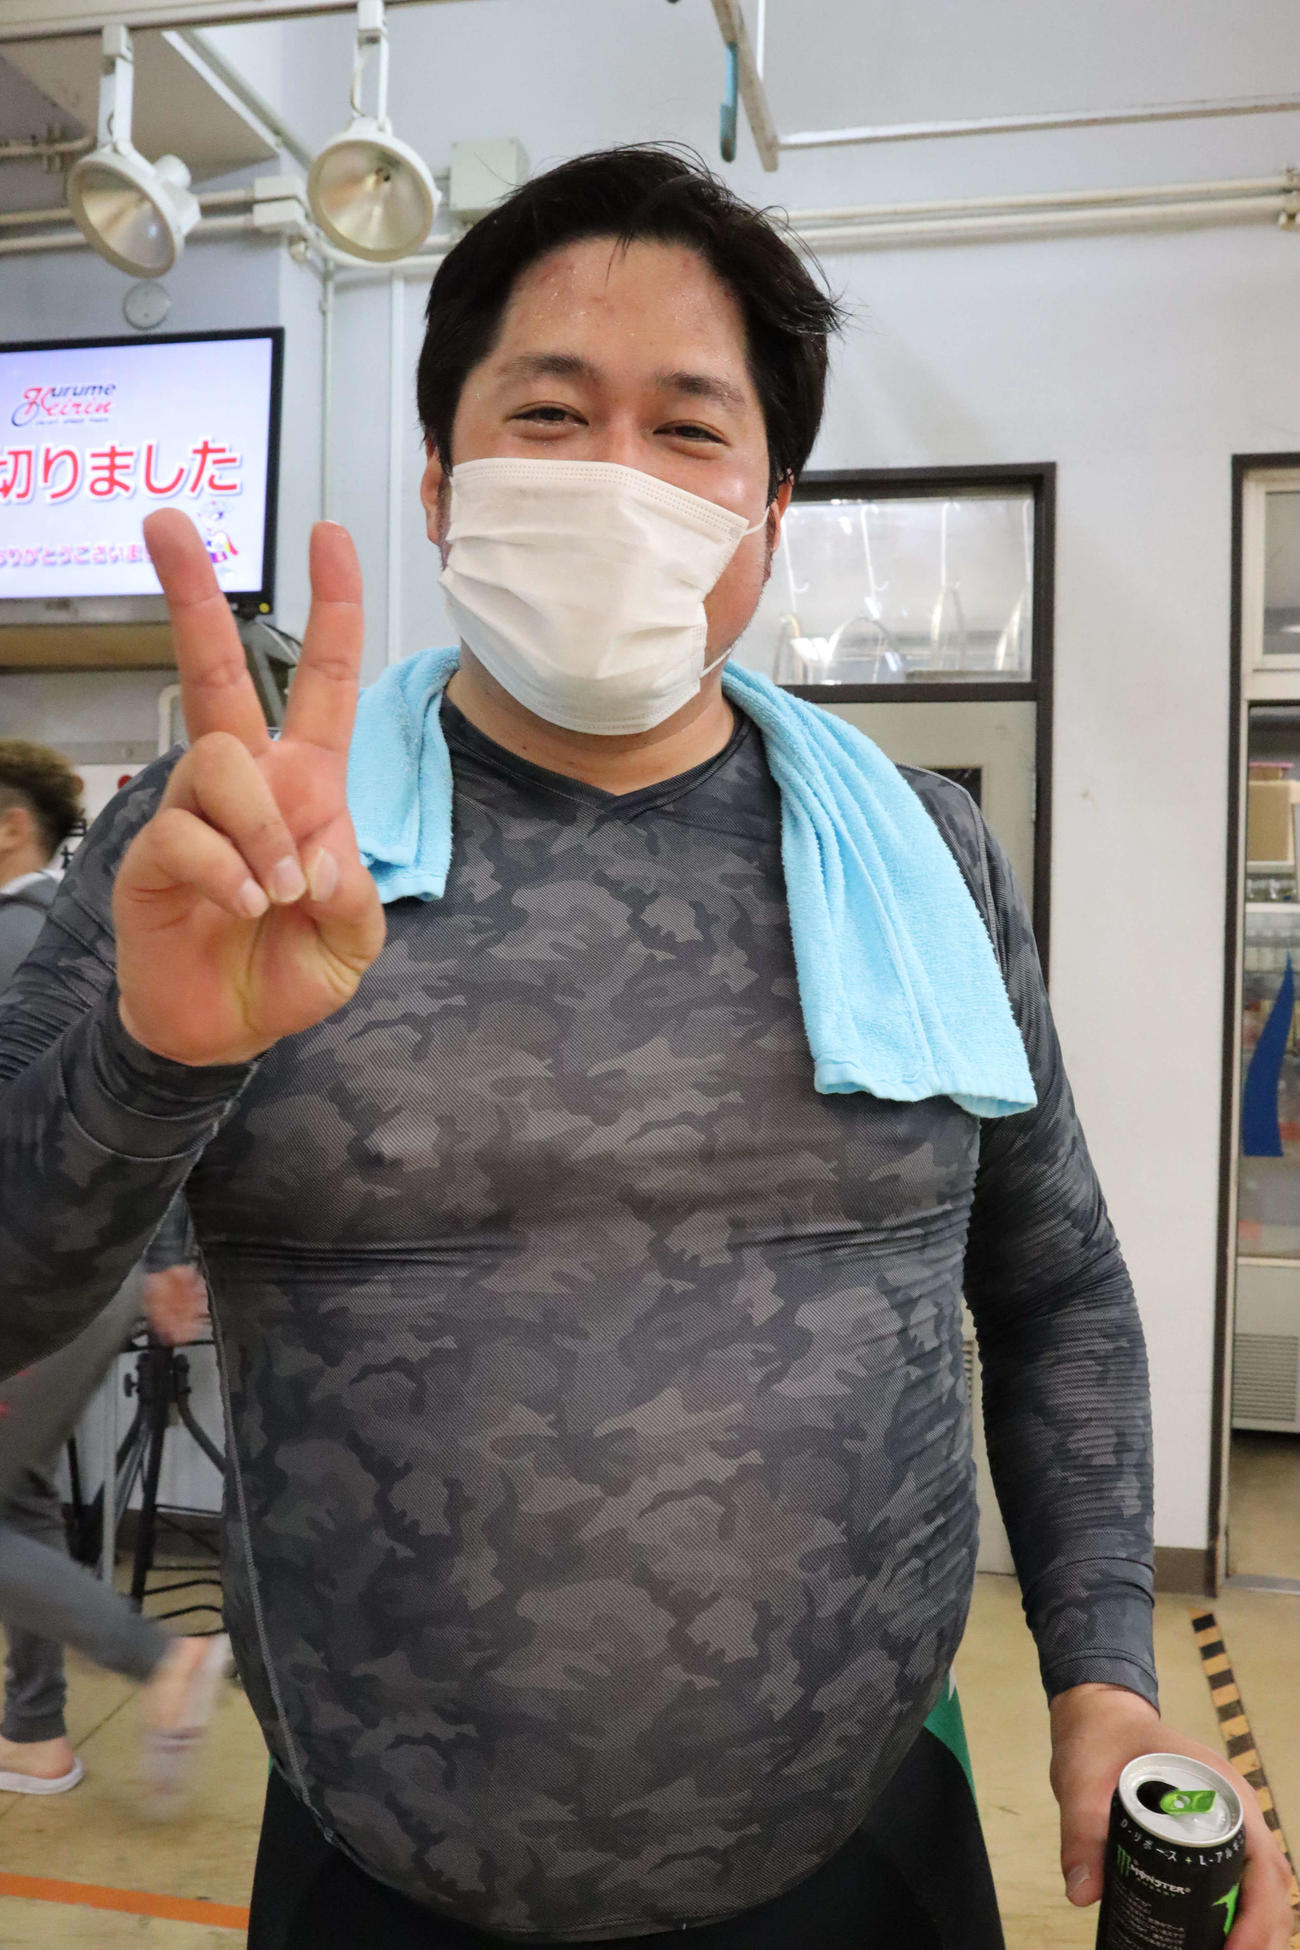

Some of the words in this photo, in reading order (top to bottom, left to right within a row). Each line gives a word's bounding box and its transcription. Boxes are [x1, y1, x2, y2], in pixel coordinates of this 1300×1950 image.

[0, 440, 238, 499] 切りました
